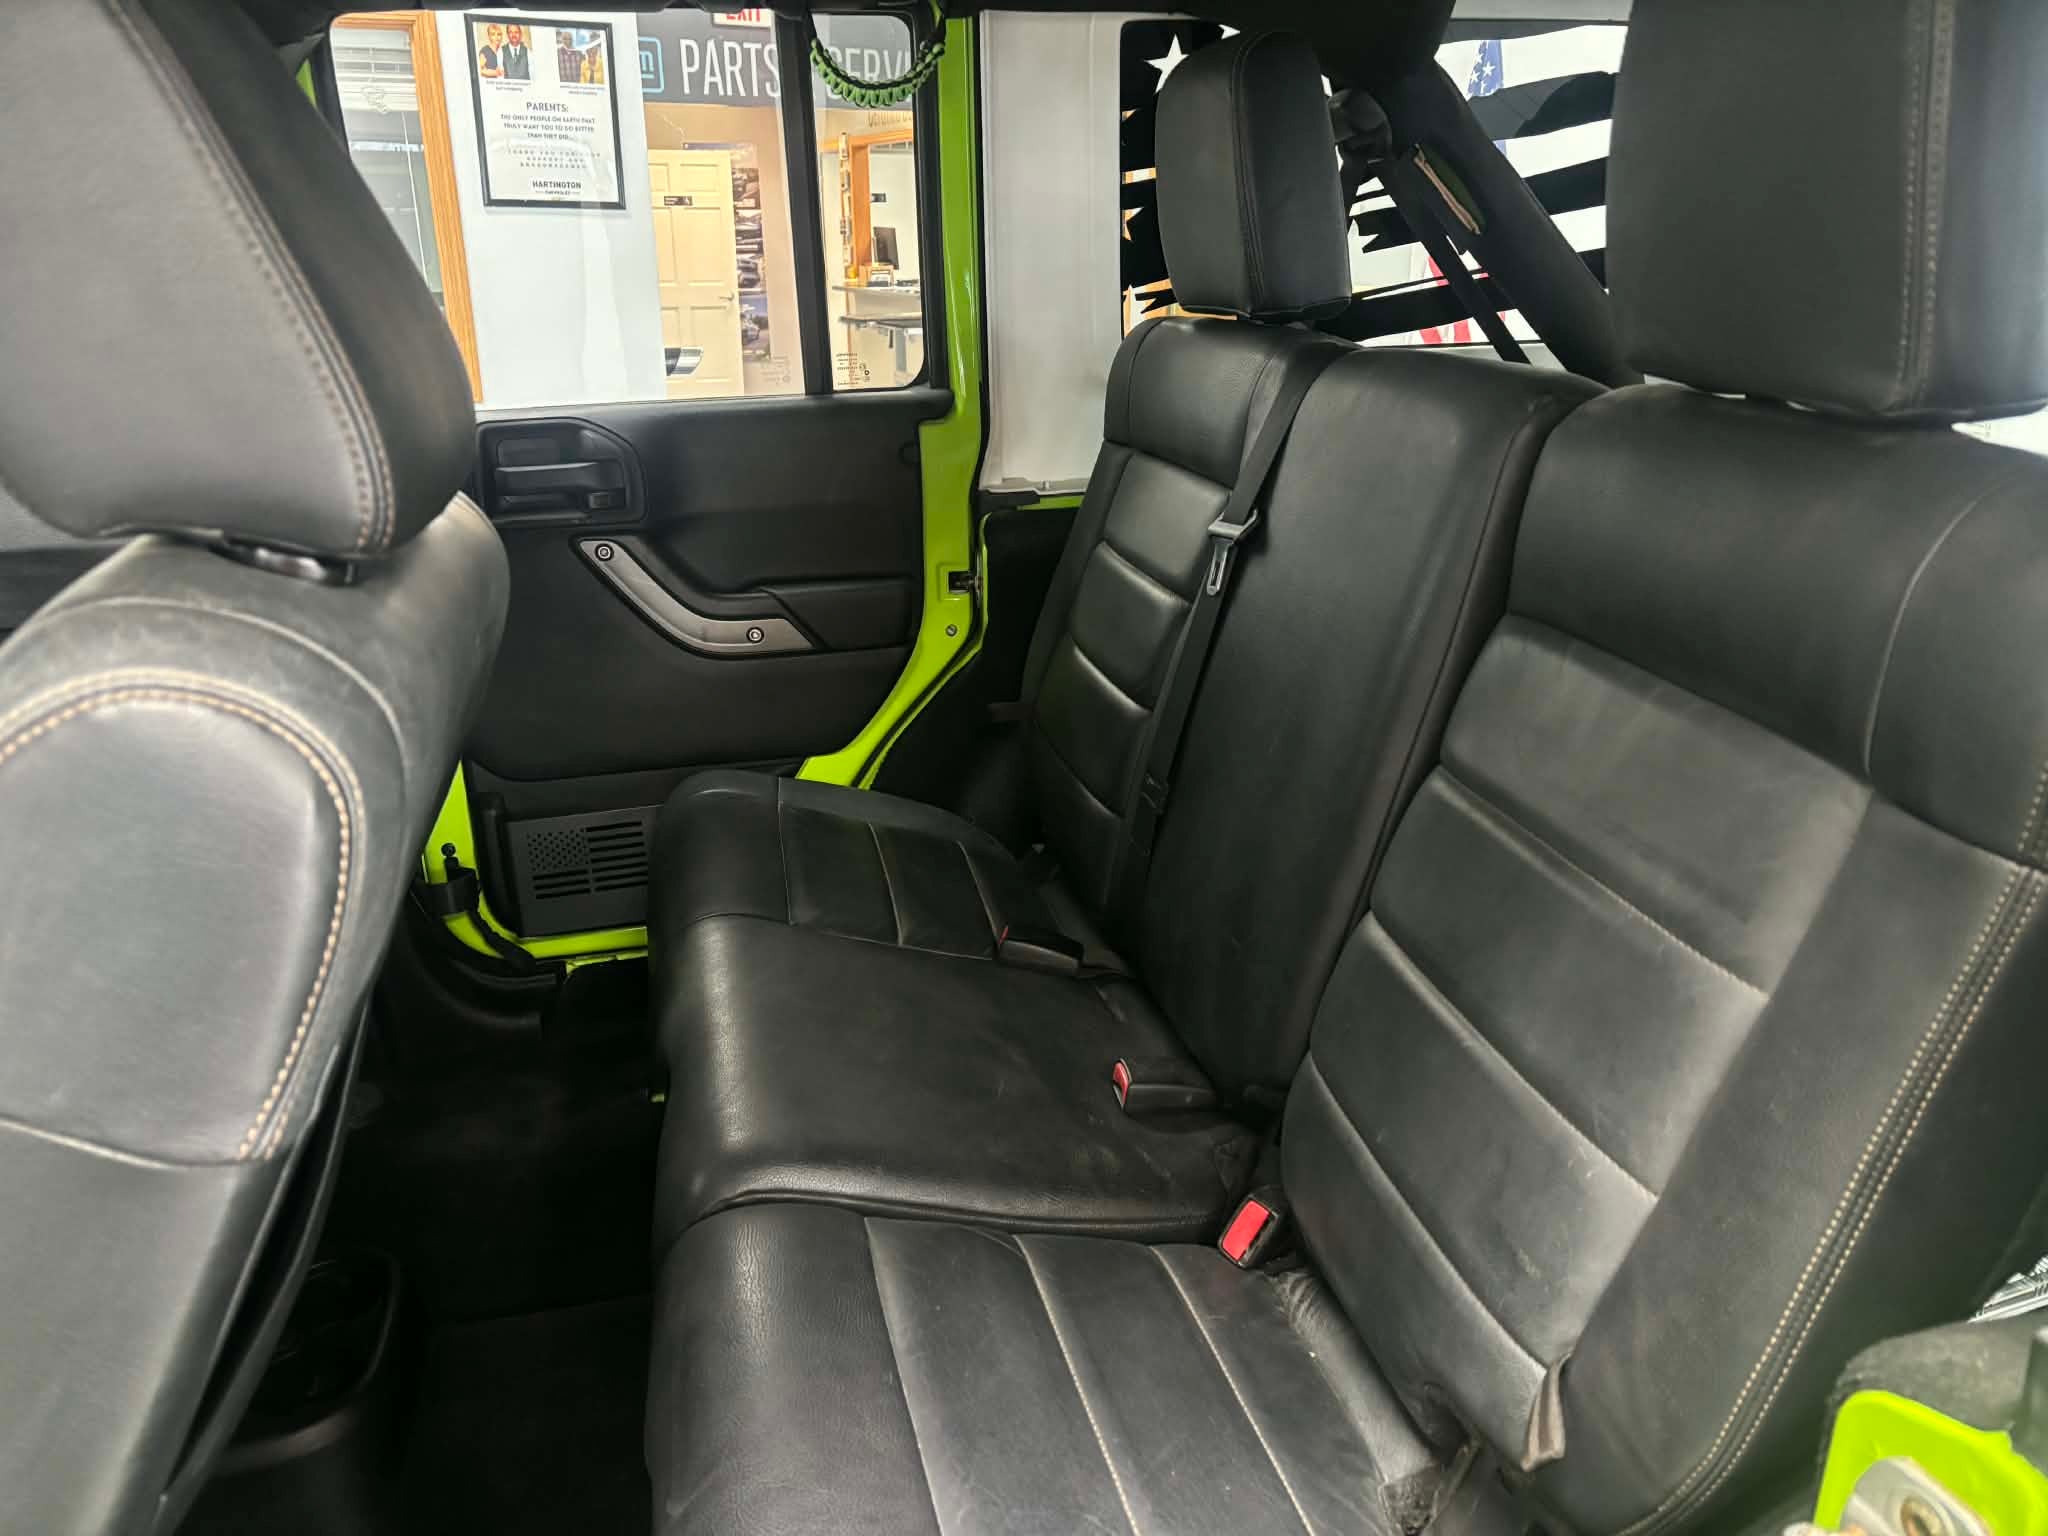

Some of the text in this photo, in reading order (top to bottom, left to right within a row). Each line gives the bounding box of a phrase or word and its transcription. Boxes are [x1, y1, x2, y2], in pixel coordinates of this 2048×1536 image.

[726, 9, 761, 24] XIT
[679, 38, 780, 98] PARTS
[526, 101, 569, 113] PARENTS:
